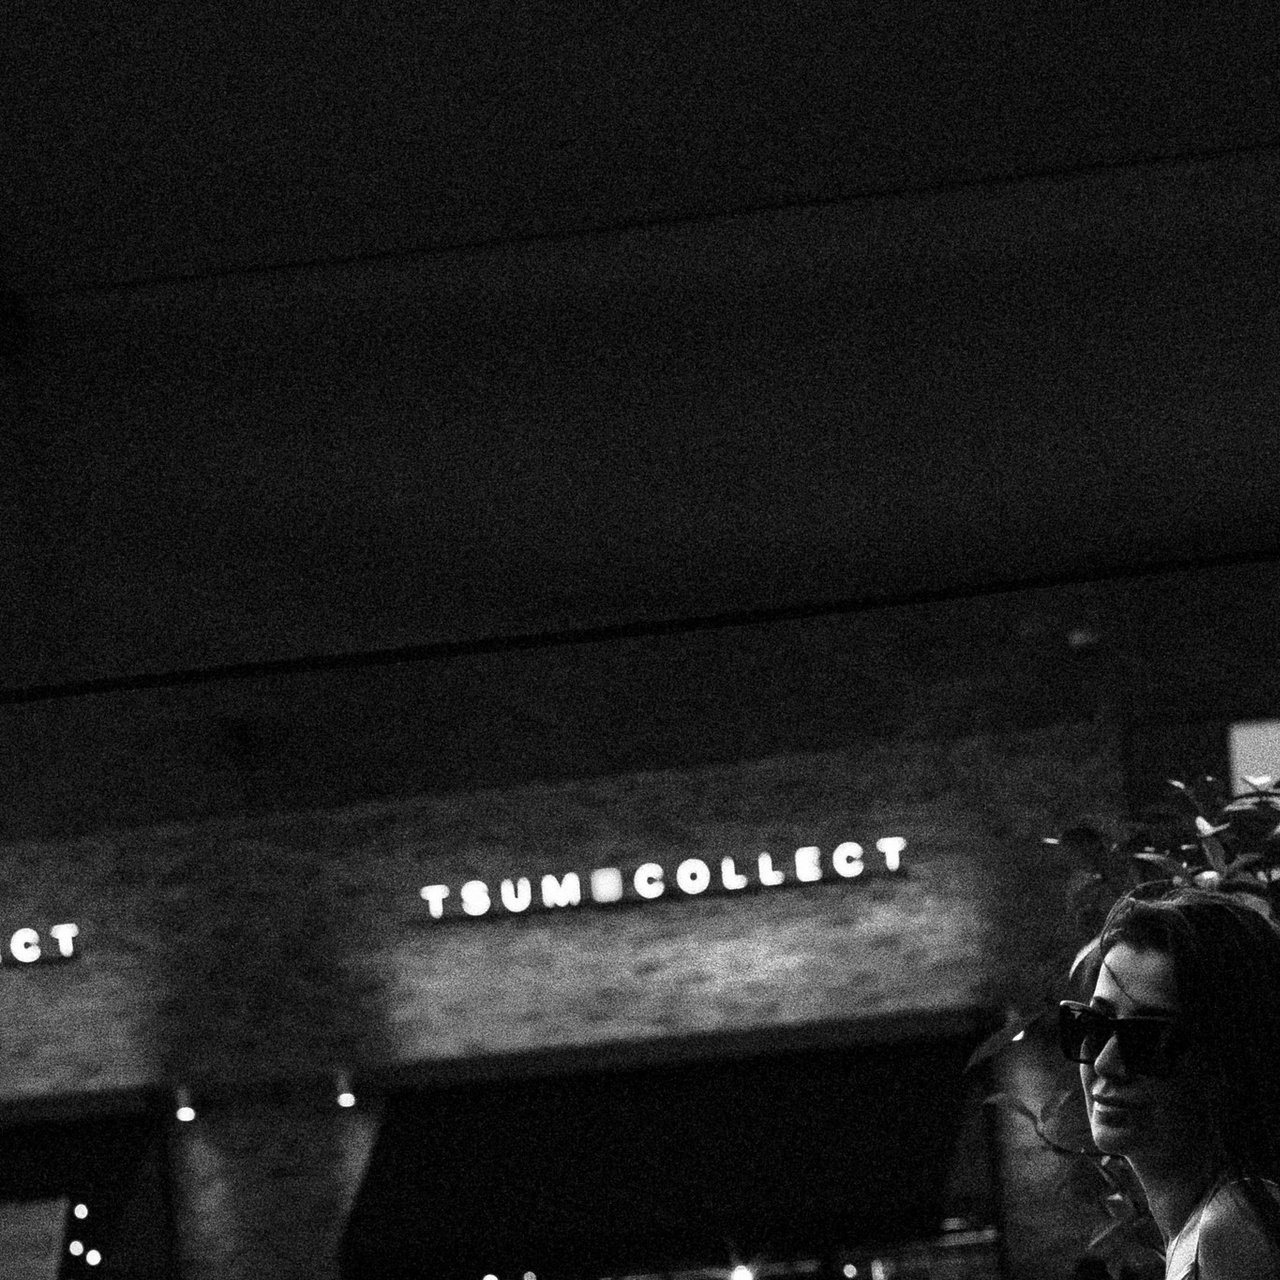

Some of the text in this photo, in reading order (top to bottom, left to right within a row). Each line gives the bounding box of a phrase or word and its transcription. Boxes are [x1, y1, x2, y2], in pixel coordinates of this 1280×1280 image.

[421, 837, 907, 919] TSUM COLLECT
[0, 923, 80, 963] CT
